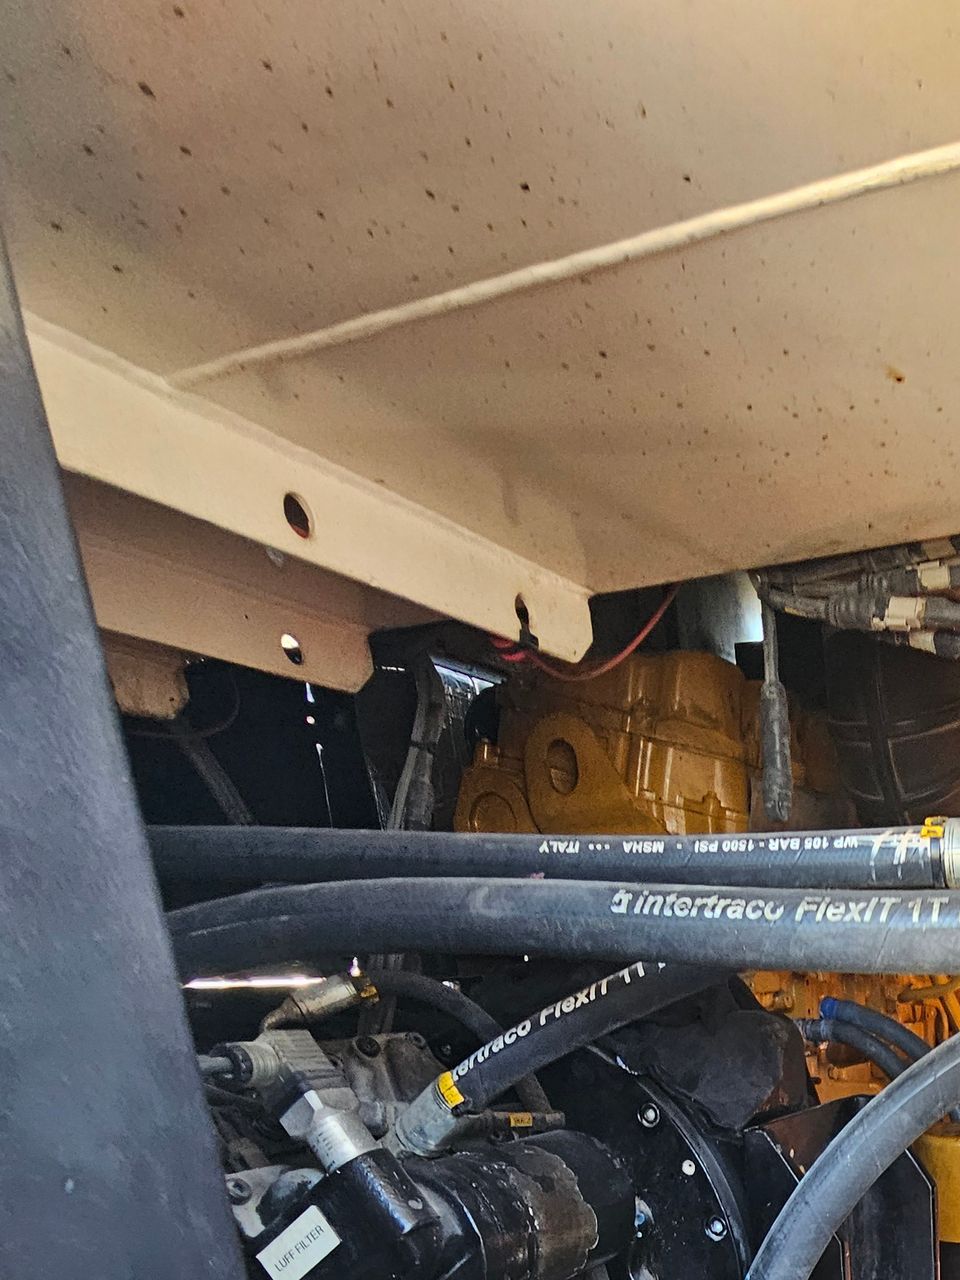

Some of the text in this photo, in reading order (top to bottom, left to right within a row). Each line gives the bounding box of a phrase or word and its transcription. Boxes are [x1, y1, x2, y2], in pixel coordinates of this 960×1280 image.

[538, 839, 580, 855] ITALY
[622, 839, 665, 855] MSHA
[694, 838, 718, 853] PSI
[722, 838, 755, 853] 1500
[768, 836, 801, 851] BAR
[805, 836, 829, 850] 105
[832, 835, 859, 849] WP
[633, 890, 785, 921] intertraco
[795, 896, 901, 924] FlexIT
[909, 896, 950, 924] 1T
[274, 1224, 325, 1272] LUFF FILTER
